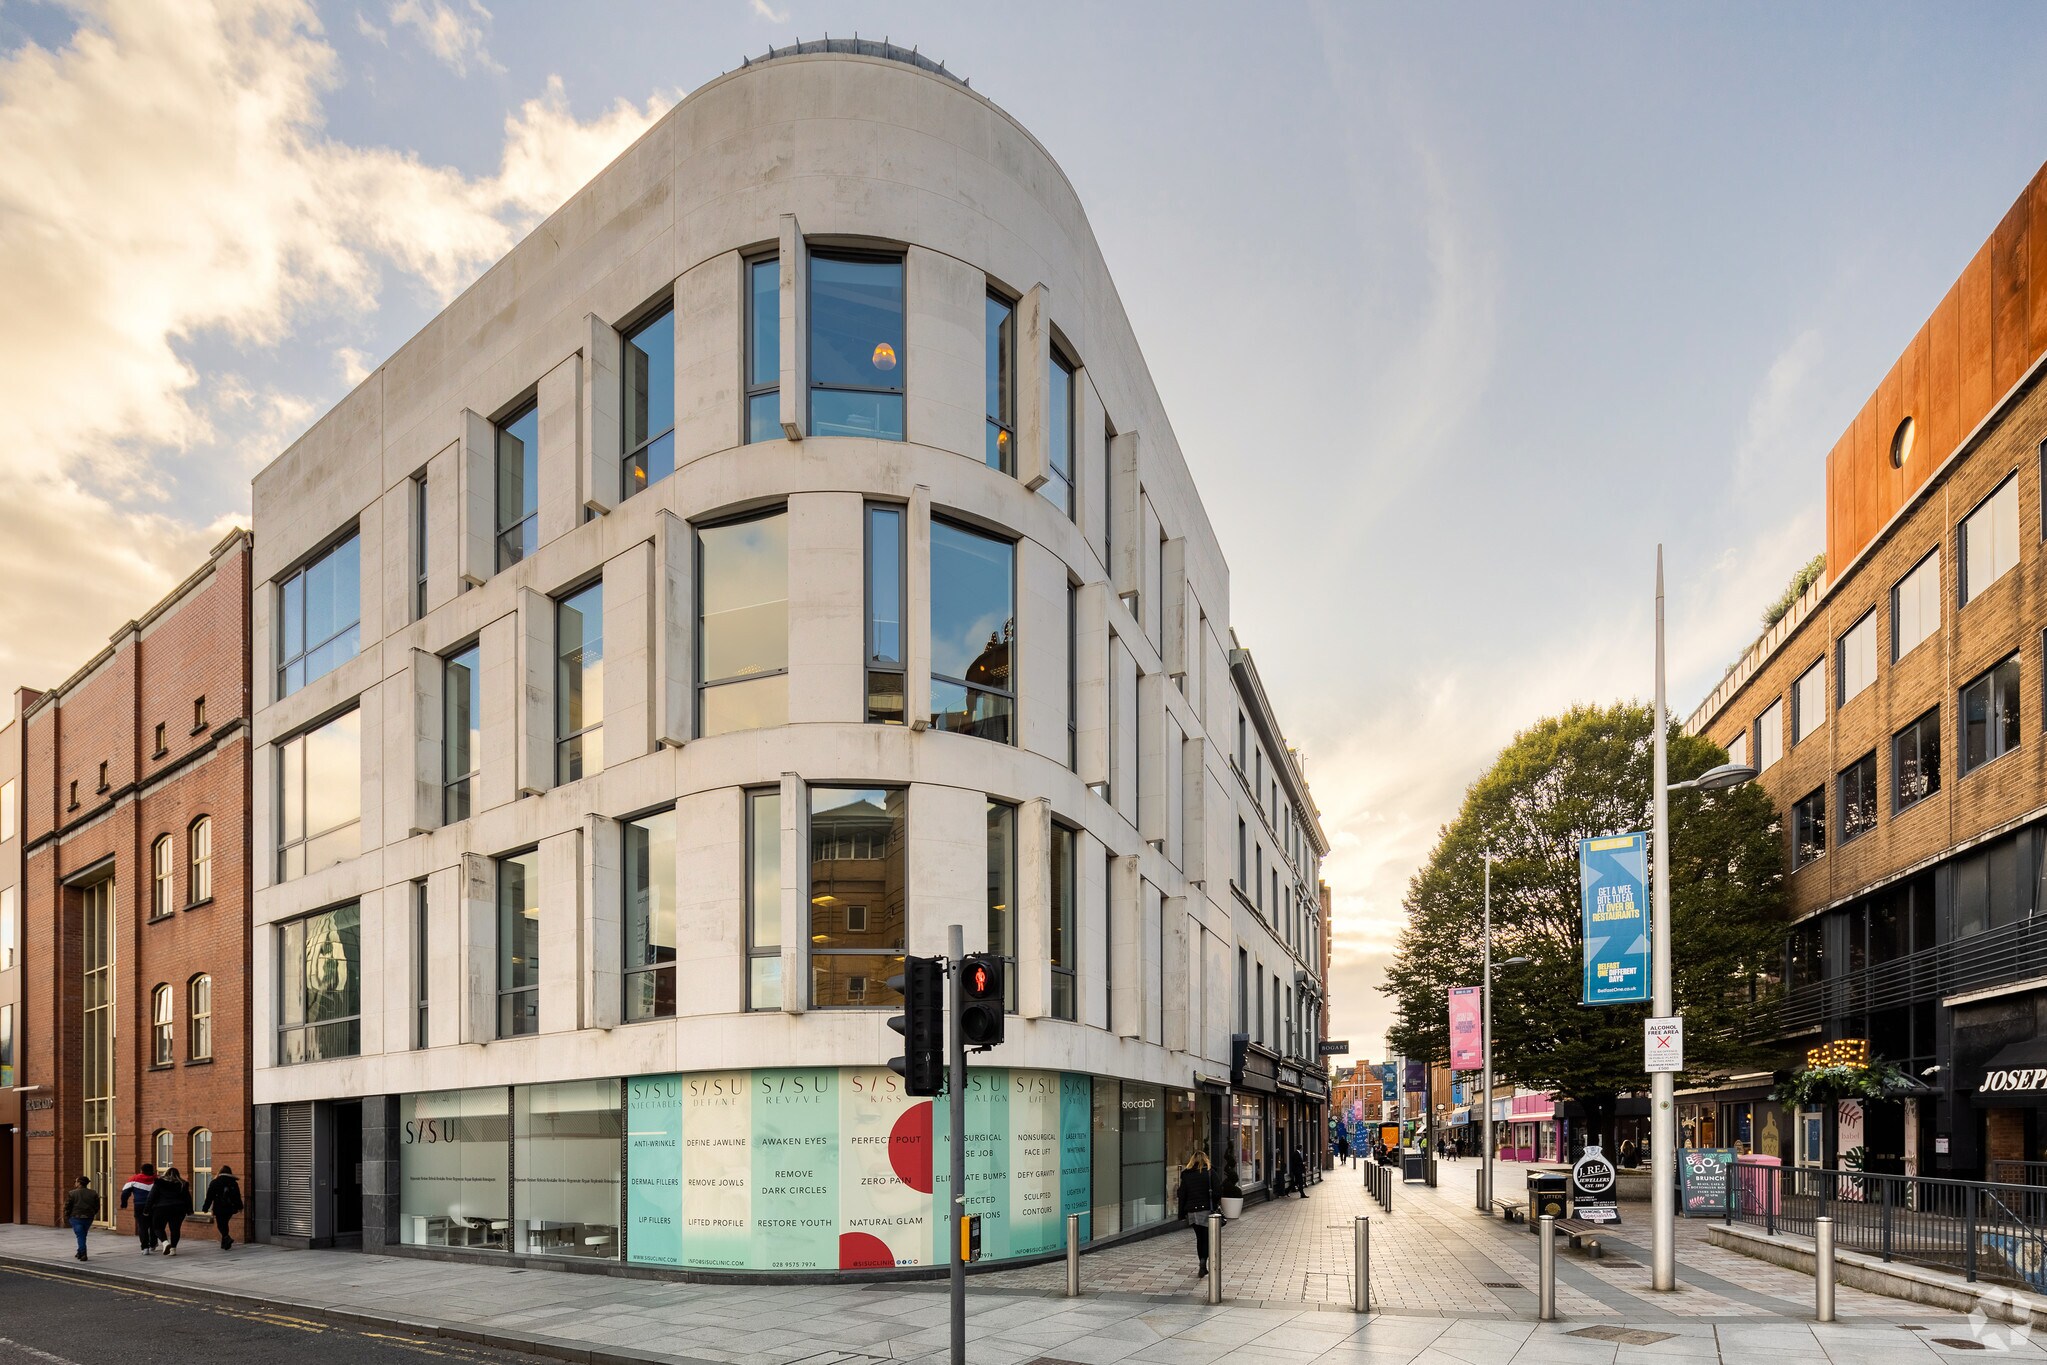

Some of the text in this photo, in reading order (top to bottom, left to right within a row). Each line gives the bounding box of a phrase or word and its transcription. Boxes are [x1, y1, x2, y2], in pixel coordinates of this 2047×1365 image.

[1598, 885, 1632, 896] GET A WEE
[1597, 893, 1634, 904] BITE TO EAT
[1597, 904, 1605, 913] AT
[1606, 902, 1623, 912] OVER
[1592, 909, 1640, 922] RESTAURANTS
[1597, 962, 1620, 970] BELFAST
[1608, 967, 1637, 976] DIFFERENT
[1979, 1069, 2047, 1092] JOSEP
[628, 1100, 683, 1109] NJECTABLES
[851, 1135, 921, 1144] PERFECT POUT
[944, 1134, 1002, 1142] NSURGICAL
[1018, 1133, 1056, 1141] NONSURGICAL
[1841, 1132, 1860, 1140] babel
[634, 1139, 676, 1147] ANTI-WRINKLE
[686, 1138, 746, 1147] DEFINE JAWLINE
[804, 1137, 827, 1145] EYES
[978, 1149, 994, 1157] JOB
[1024, 1147, 1051, 1156] FACE LIFT
[1686, 1156, 1727, 1174] BOOZ
[775, 1170, 813, 1178] REMOVE
[1017, 1169, 1055, 1179] DEFY GRAVITY
[1578, 1164, 1609, 1178] J. REA
[861, 1176, 912, 1185] ZERO PAIN
[935, 1172, 1007, 1183] ELIATE BUMPS
[631, 1178, 679, 1187] DERMAL FILLERS
[688, 1179, 744, 1187] REMOVE JOWLS
[761, 1186, 827, 1195] DARK CIRCLES
[1024, 1192, 1052, 1201] SCULPTED
[1022, 1206, 1052, 1216] CONTOURS
[638, 1216, 671, 1225] LIP FILLERS
[688, 1219, 744, 1227] LIFTED PROFILE
[757, 1219, 832, 1227] RESTORE YOUTH
[849, 1217, 923, 1226] NATURAL GLAM
[1014, 1244, 1057, 1254] INFO@SISUCLINIC.COM
[633, 1255, 678, 1263] WWW.SISUCLINIC.COM
[688, 1258, 744, 1266] INFO@SISUCLINIC.COM
[853, 1259, 895, 1267] @SISUCLINIC
